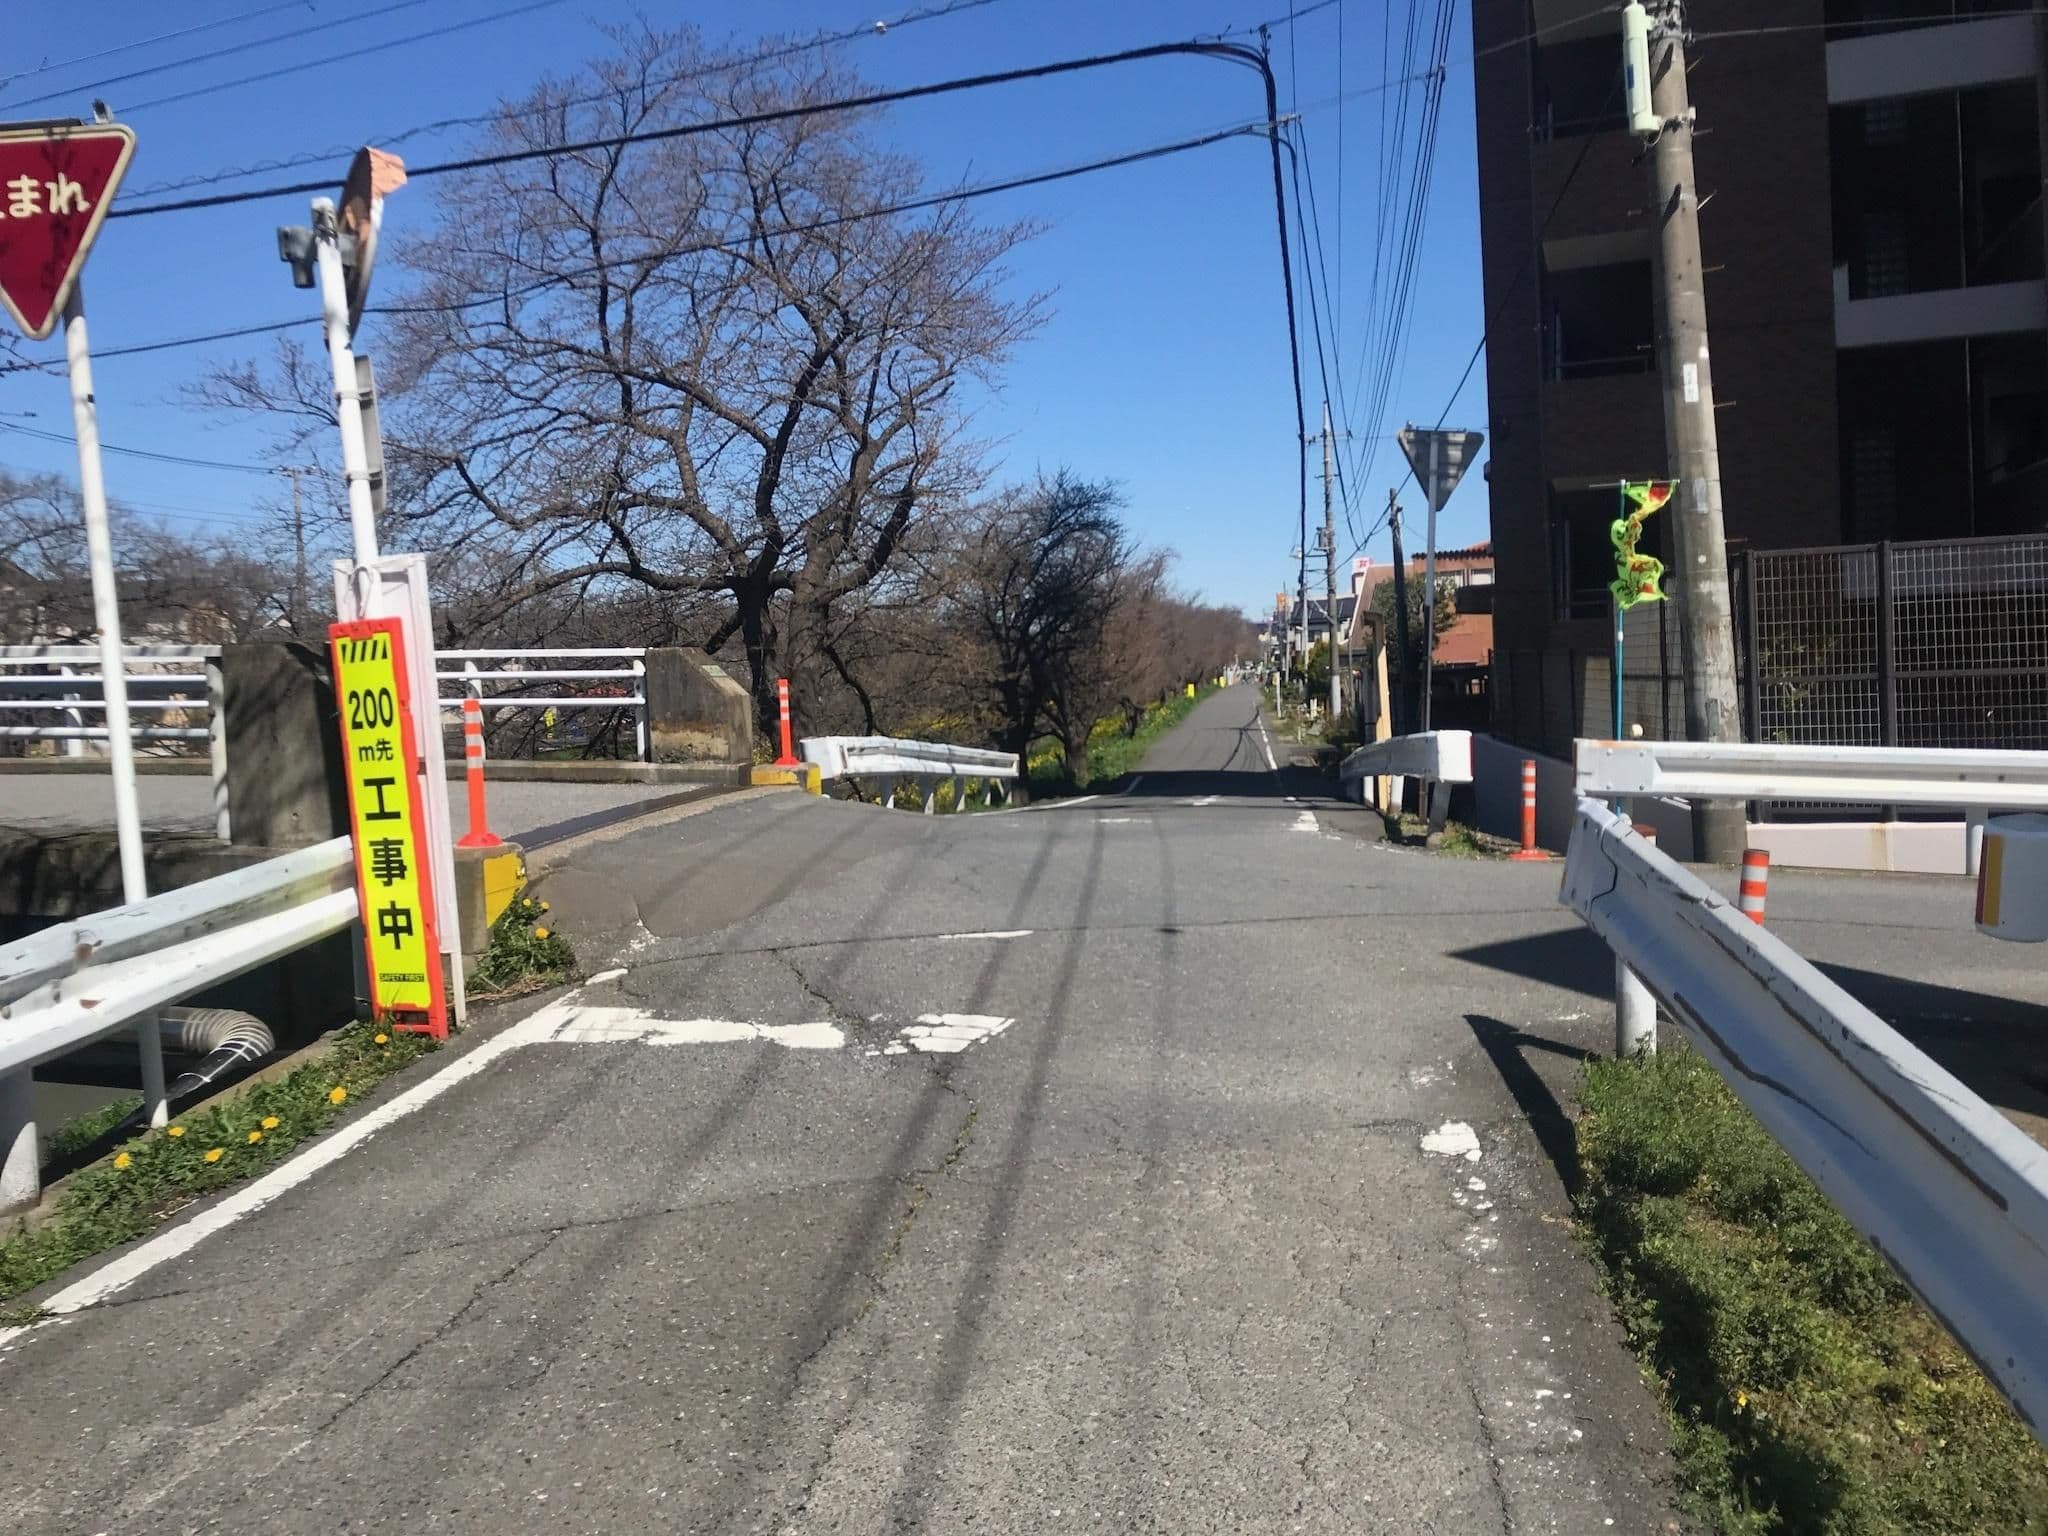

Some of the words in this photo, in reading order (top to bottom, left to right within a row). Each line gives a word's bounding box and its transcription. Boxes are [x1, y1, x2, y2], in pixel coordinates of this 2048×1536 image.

[0, 171, 91, 218] まれ
[348, 687, 394, 730] 200
[358, 738, 394, 762] m先
[363, 776, 414, 950] 工事中
